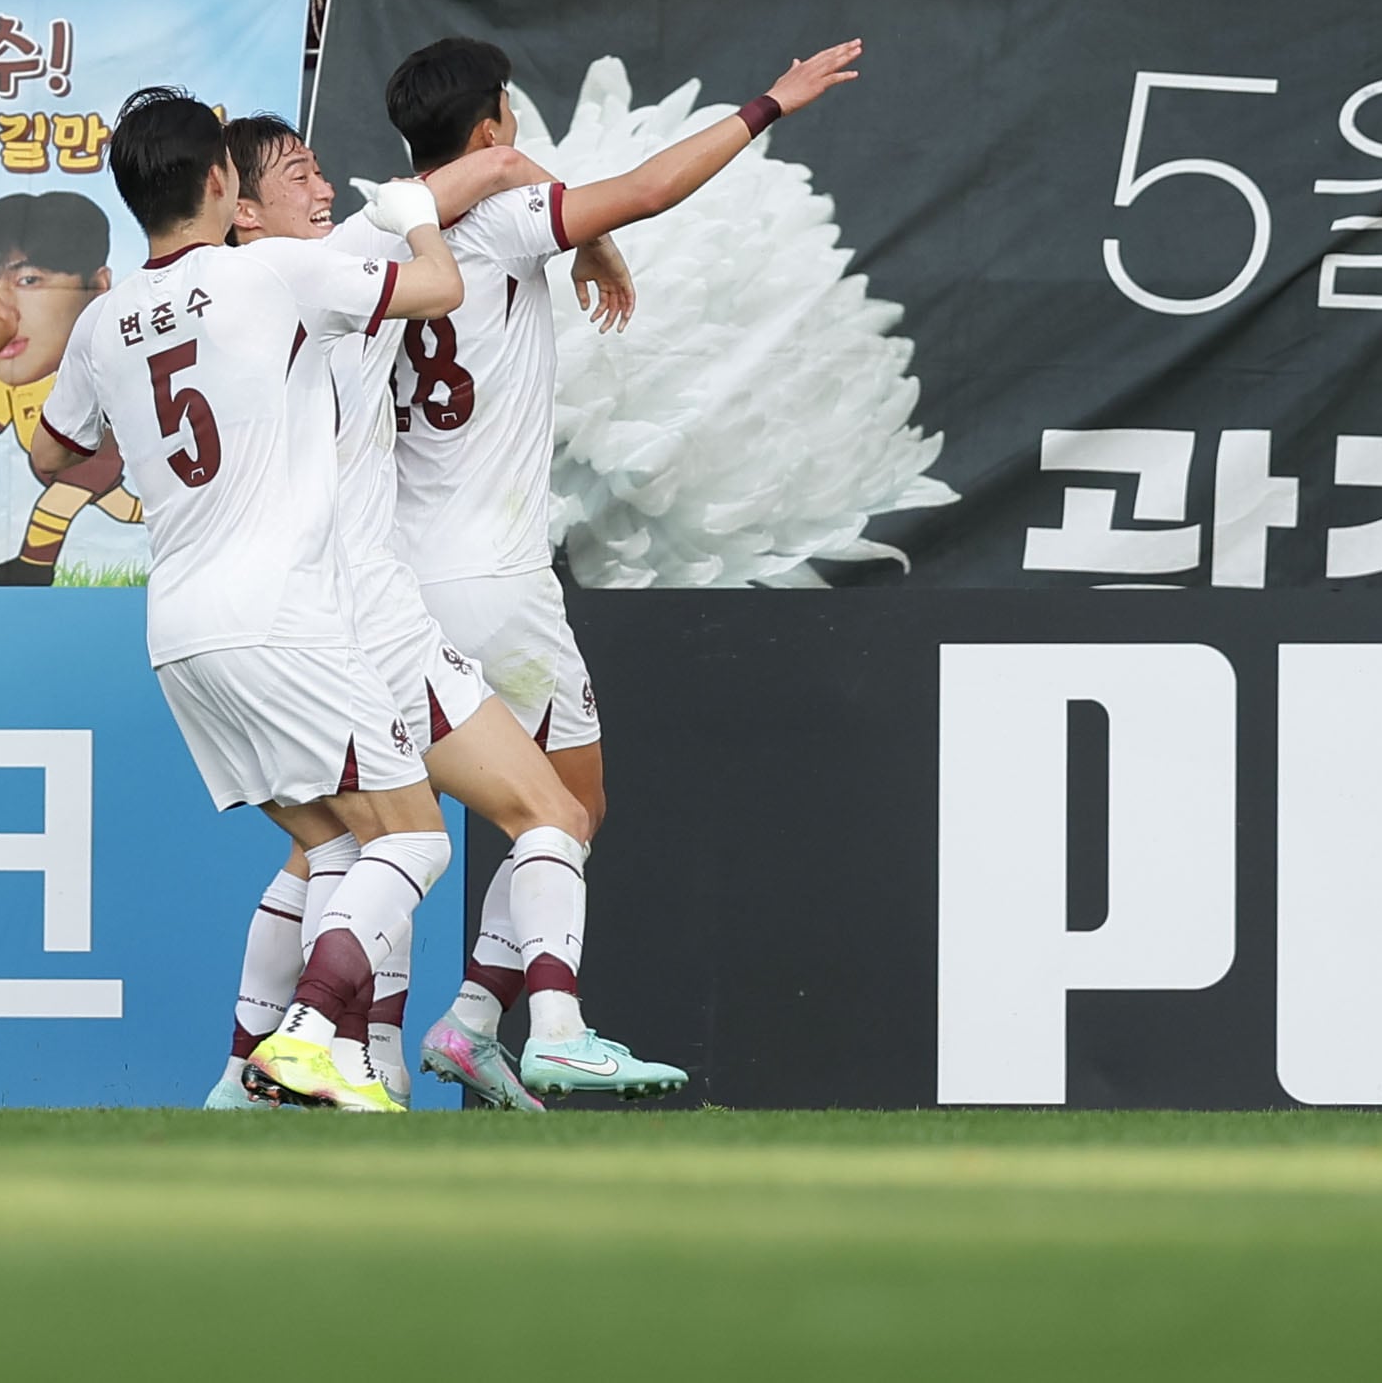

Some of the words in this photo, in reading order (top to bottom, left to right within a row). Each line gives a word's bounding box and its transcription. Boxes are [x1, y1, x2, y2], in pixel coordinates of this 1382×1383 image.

[119, 287, 213, 347] 변준수
[396, 317, 477, 433] 8
[147, 338, 223, 490] 5
